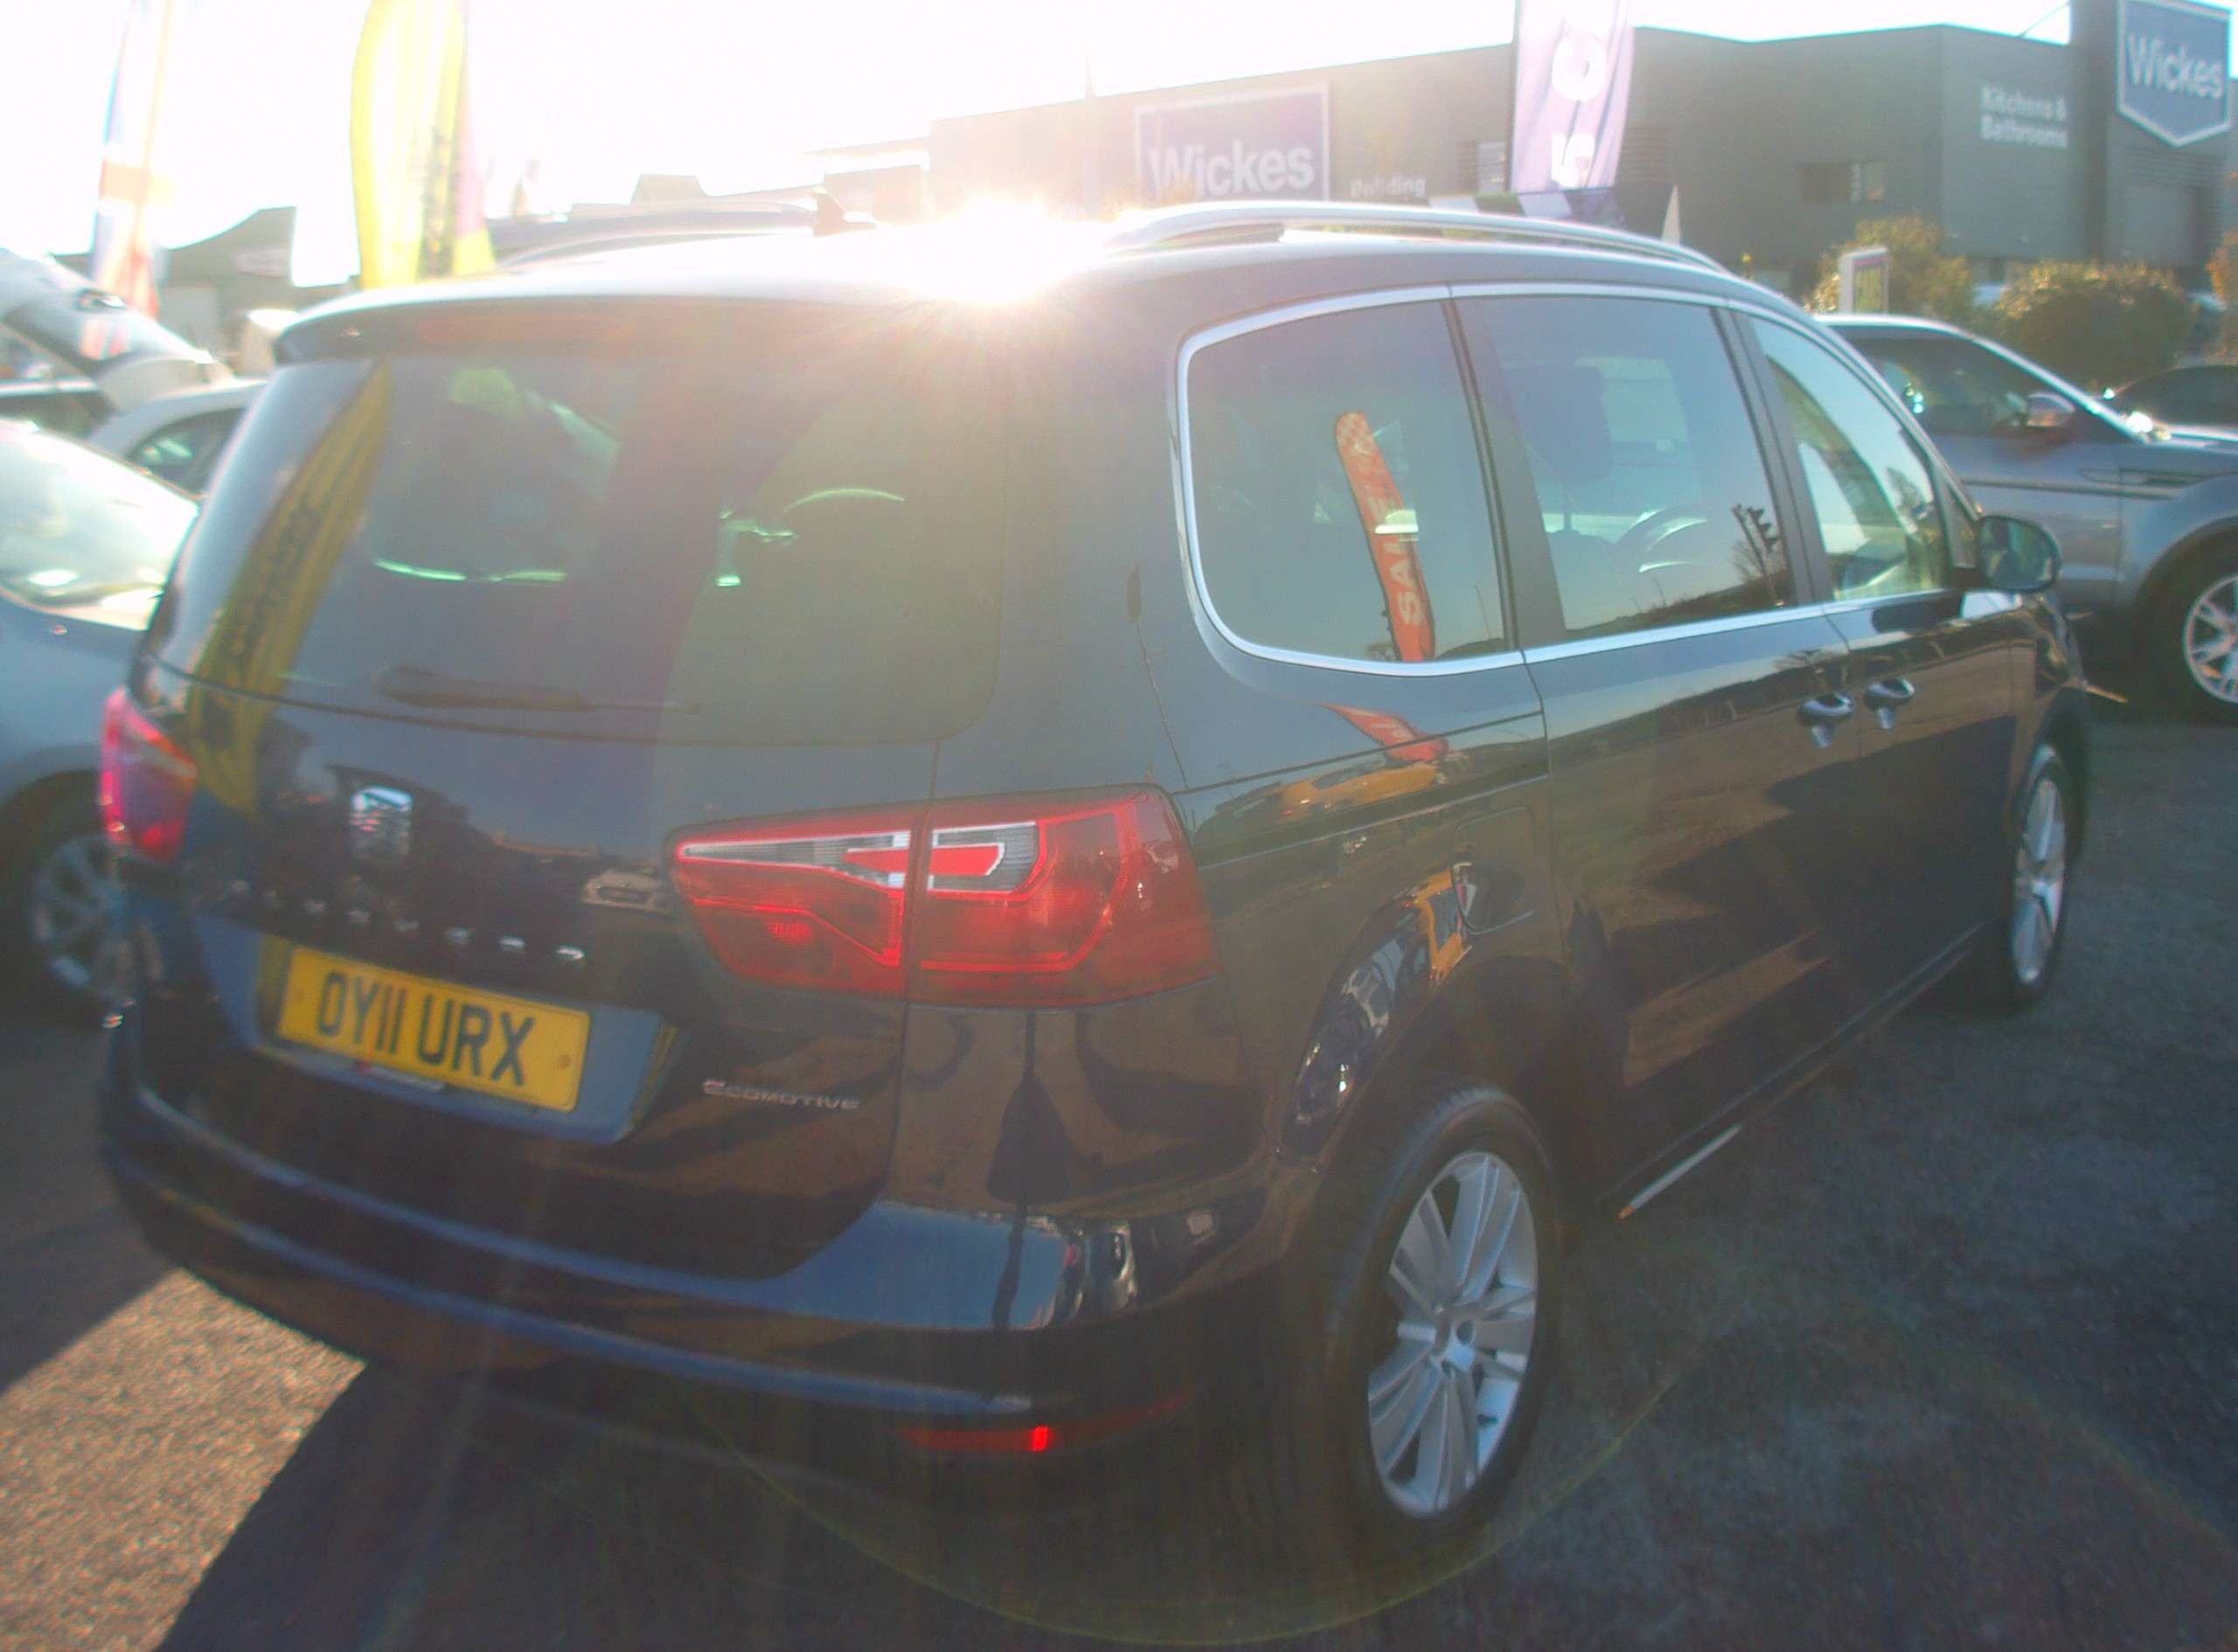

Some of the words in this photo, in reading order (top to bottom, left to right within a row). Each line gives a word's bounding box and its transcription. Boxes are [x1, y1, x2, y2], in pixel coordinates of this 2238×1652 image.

[2127, 33, 2223, 100] Wickes
[1148, 140, 1315, 199] Wickes
[317, 971, 405, 1055] OY11
[417, 994, 535, 1087] URX
